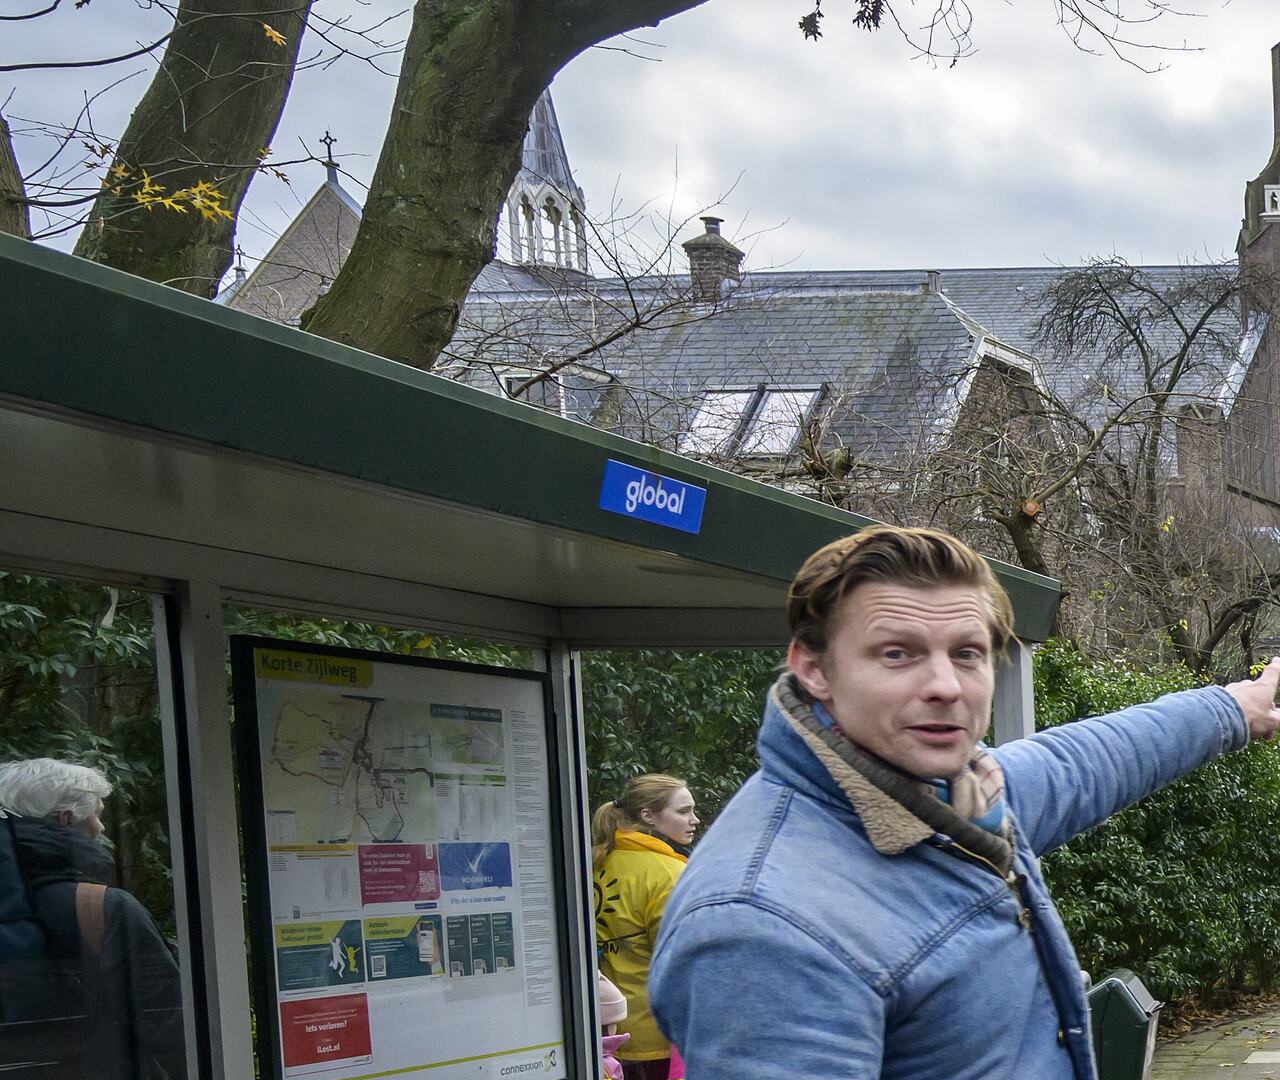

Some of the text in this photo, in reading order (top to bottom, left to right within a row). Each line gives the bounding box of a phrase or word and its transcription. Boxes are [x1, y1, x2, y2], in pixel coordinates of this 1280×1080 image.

[625, 473, 686, 515] global
[261, 653, 357, 683] Korte Zijlweg
